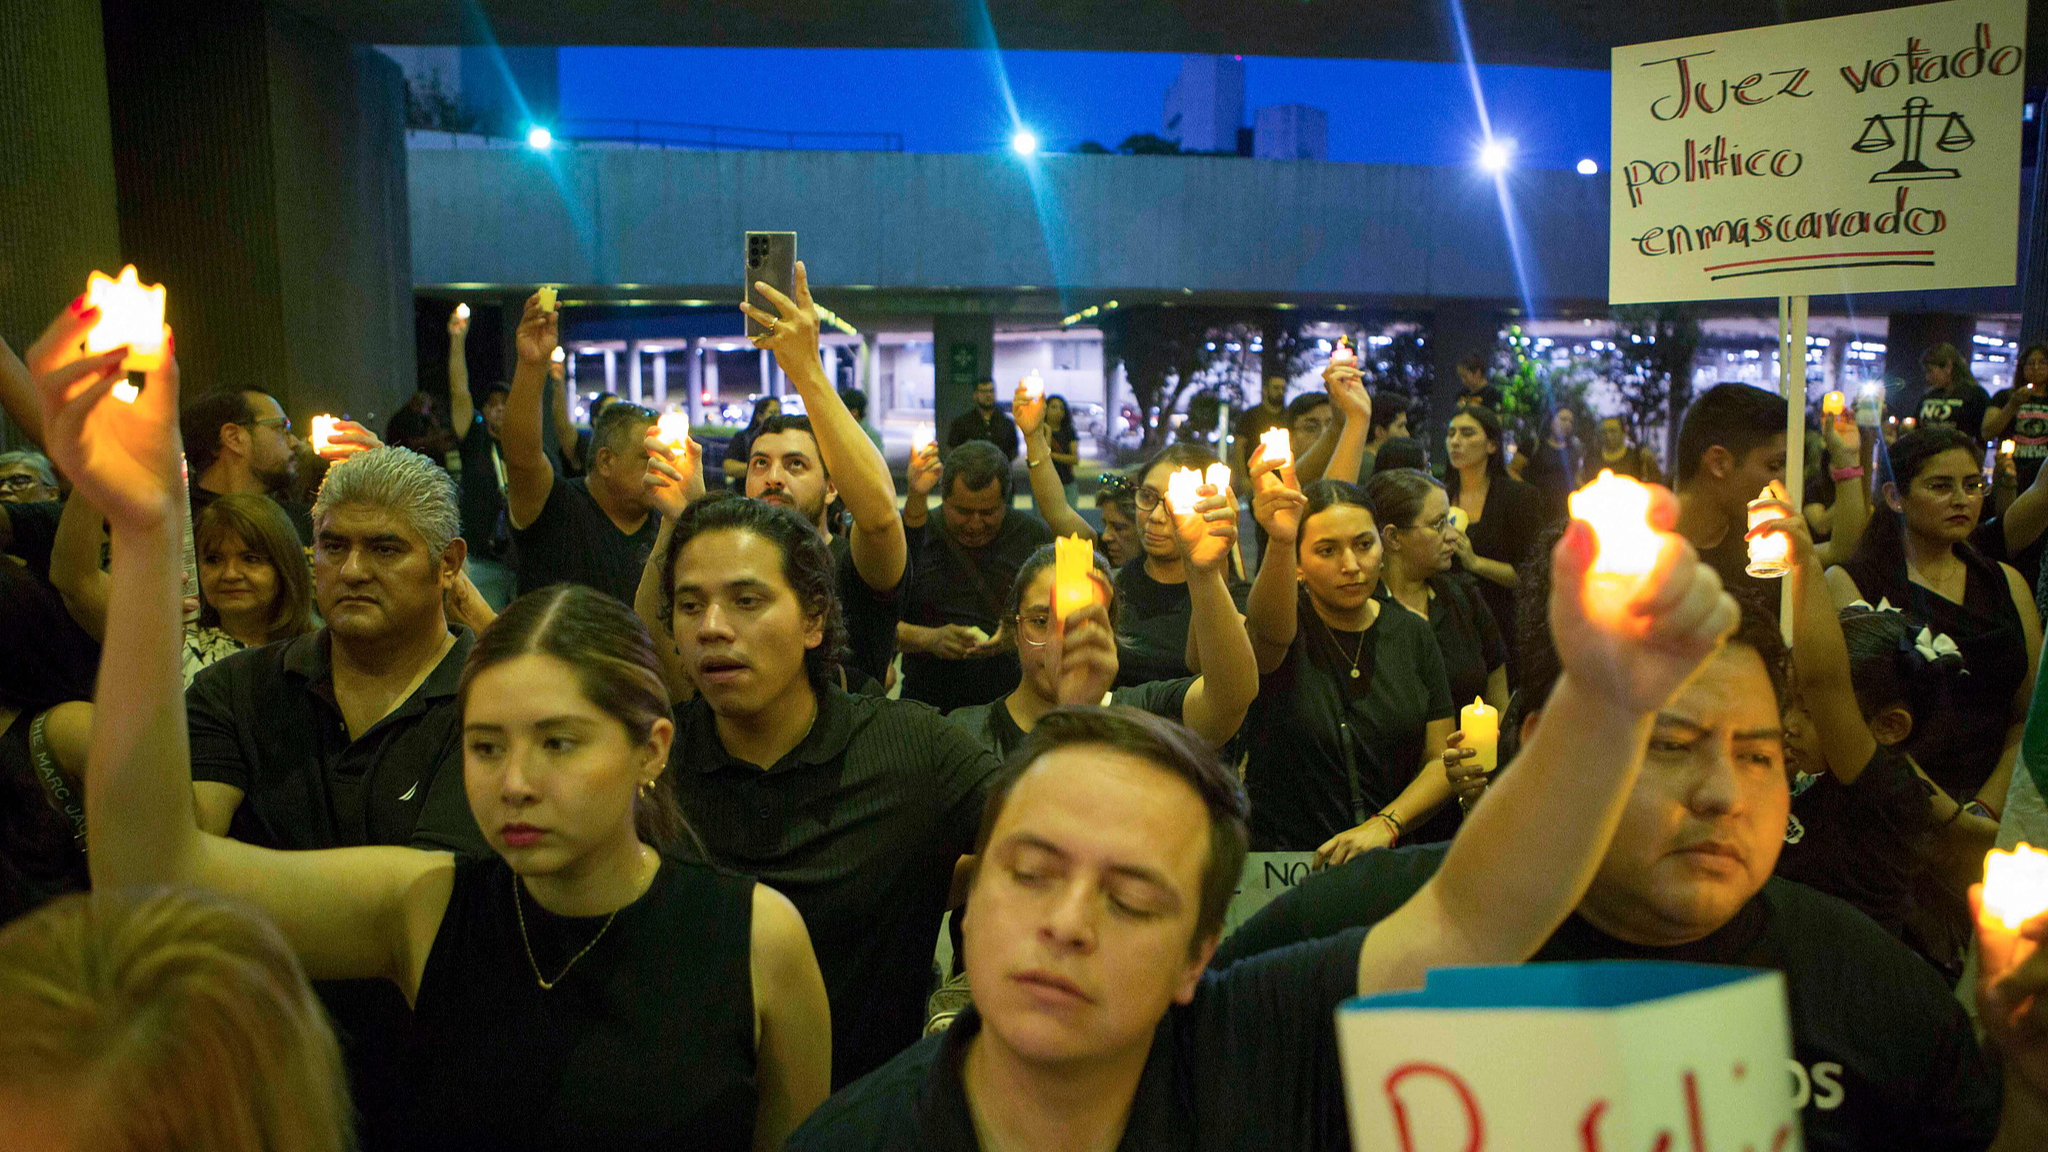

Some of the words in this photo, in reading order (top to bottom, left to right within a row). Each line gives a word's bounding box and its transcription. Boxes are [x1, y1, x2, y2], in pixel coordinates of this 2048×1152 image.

[1640, 50, 1813, 120] Juez
[1840, 22, 2023, 94] votado
[1624, 135, 1803, 208] político
[1632, 186, 1947, 257] enmascarado
[33, 712, 49, 747] THE
[37, 752, 70, 800] MARC
